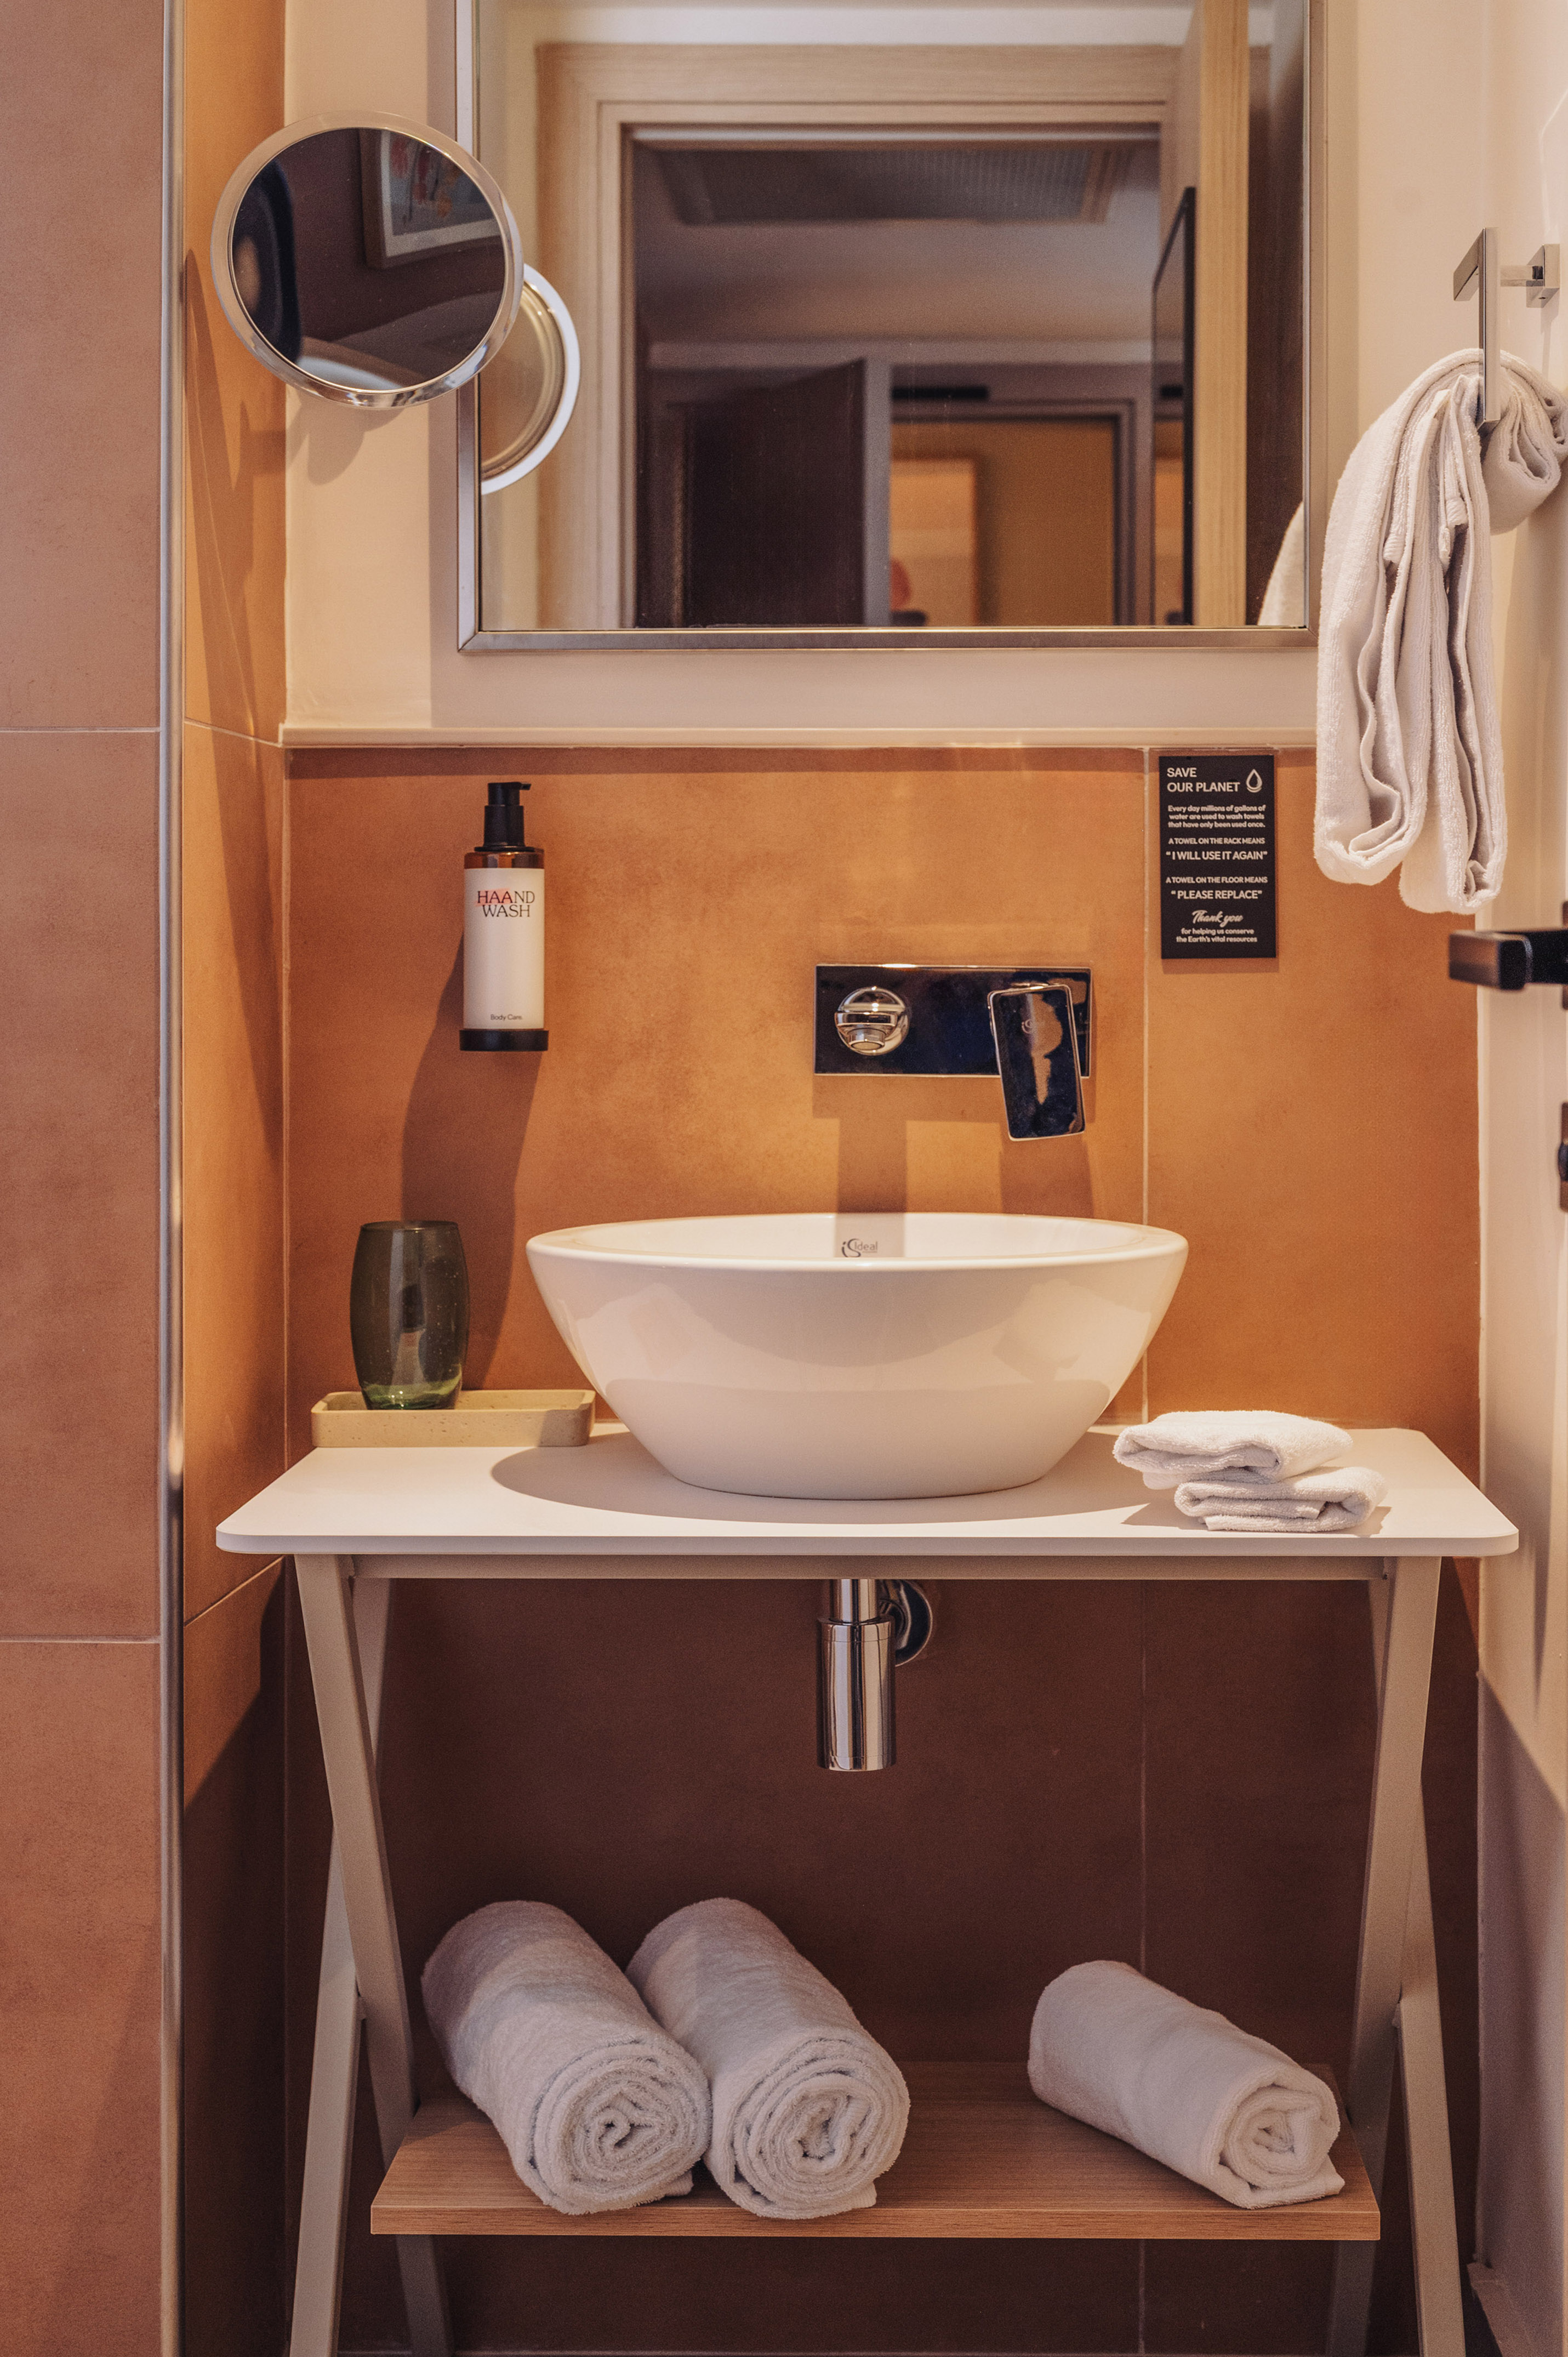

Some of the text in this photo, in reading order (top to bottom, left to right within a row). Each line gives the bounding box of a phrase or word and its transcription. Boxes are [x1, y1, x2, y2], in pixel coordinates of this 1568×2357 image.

[1167, 767, 1197, 777] SAVE
[1167, 782, 1240, 792] OUR PLANET
[1177, 851, 1201, 860] WILL
[1202, 851, 1221, 860] USE
[1222, 851, 1231, 860] IT
[477, 891, 535, 903] HAAND
[483, 904, 529, 917] WASH
[1192, 910, 1244, 927] Thank you
[854, 1241, 878, 1250] Ideal
